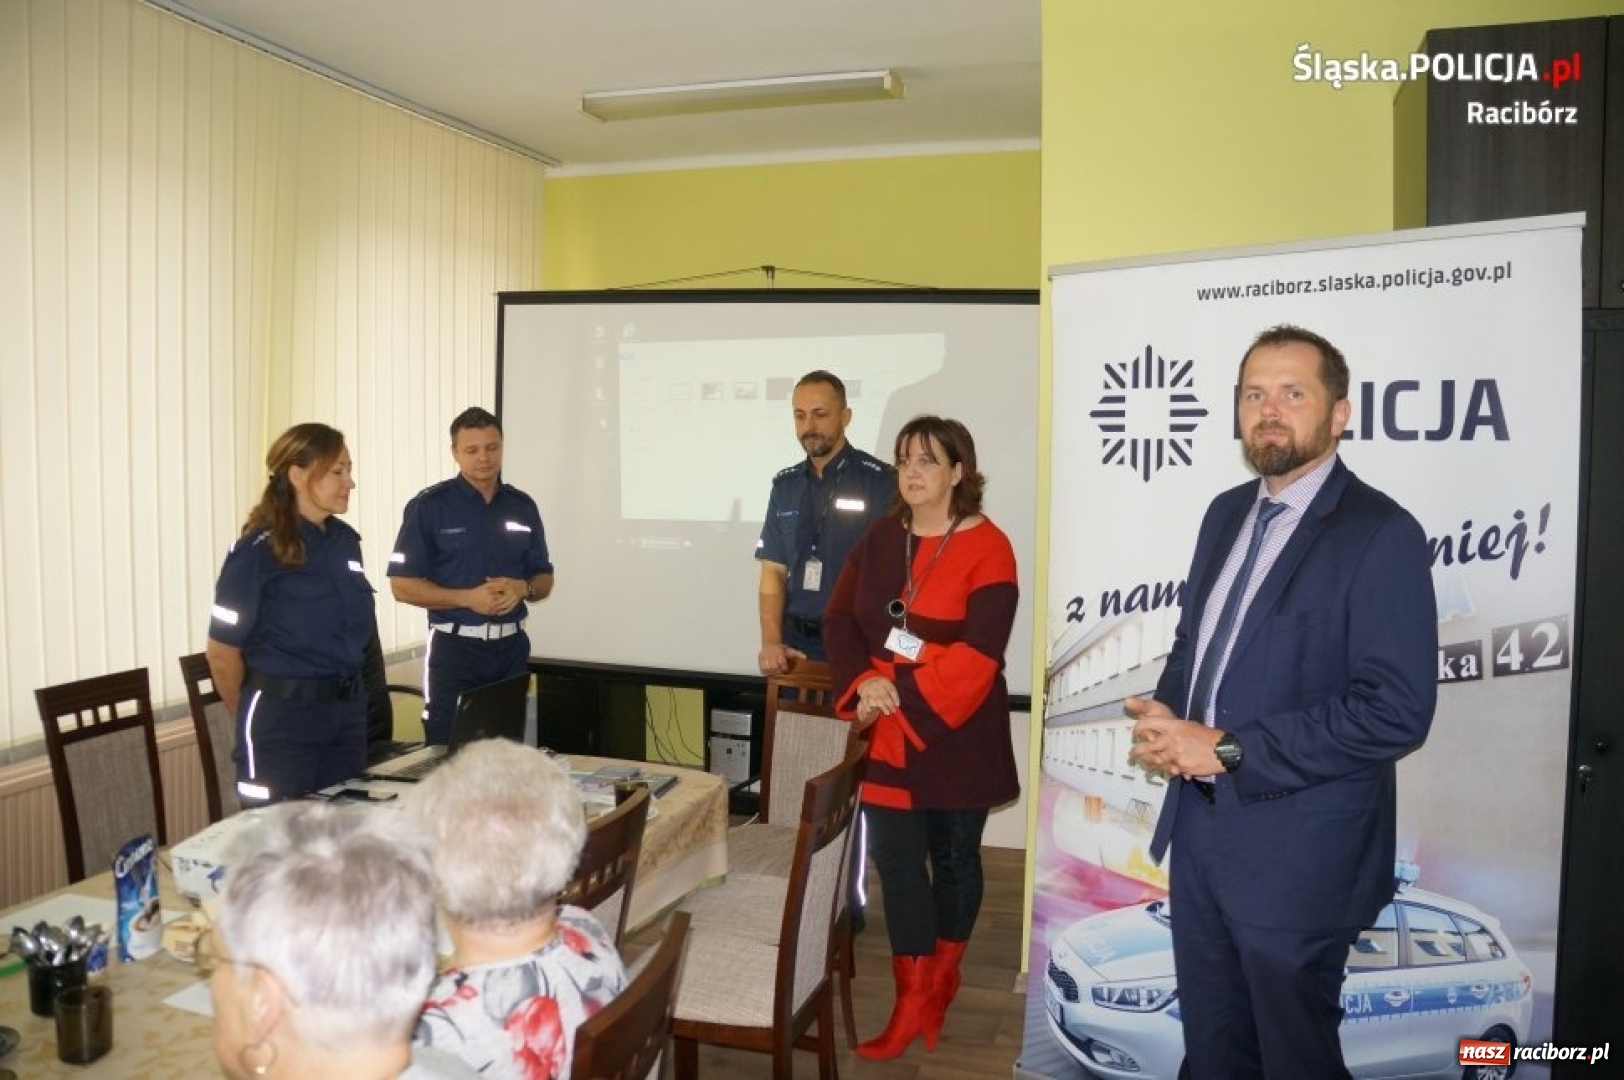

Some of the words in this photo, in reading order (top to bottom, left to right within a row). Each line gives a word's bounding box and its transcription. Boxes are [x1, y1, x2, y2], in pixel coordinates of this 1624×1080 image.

[1197, 261, 1512, 301] www.raciborz.slaska.policja.gov.pl
[1233, 378, 1510, 442] ICJA
[1066, 595, 1085, 623] z
[1100, 579, 1188, 618] nam
[1427, 502, 1551, 581] niej!
[1496, 622, 1563, 671] 42
